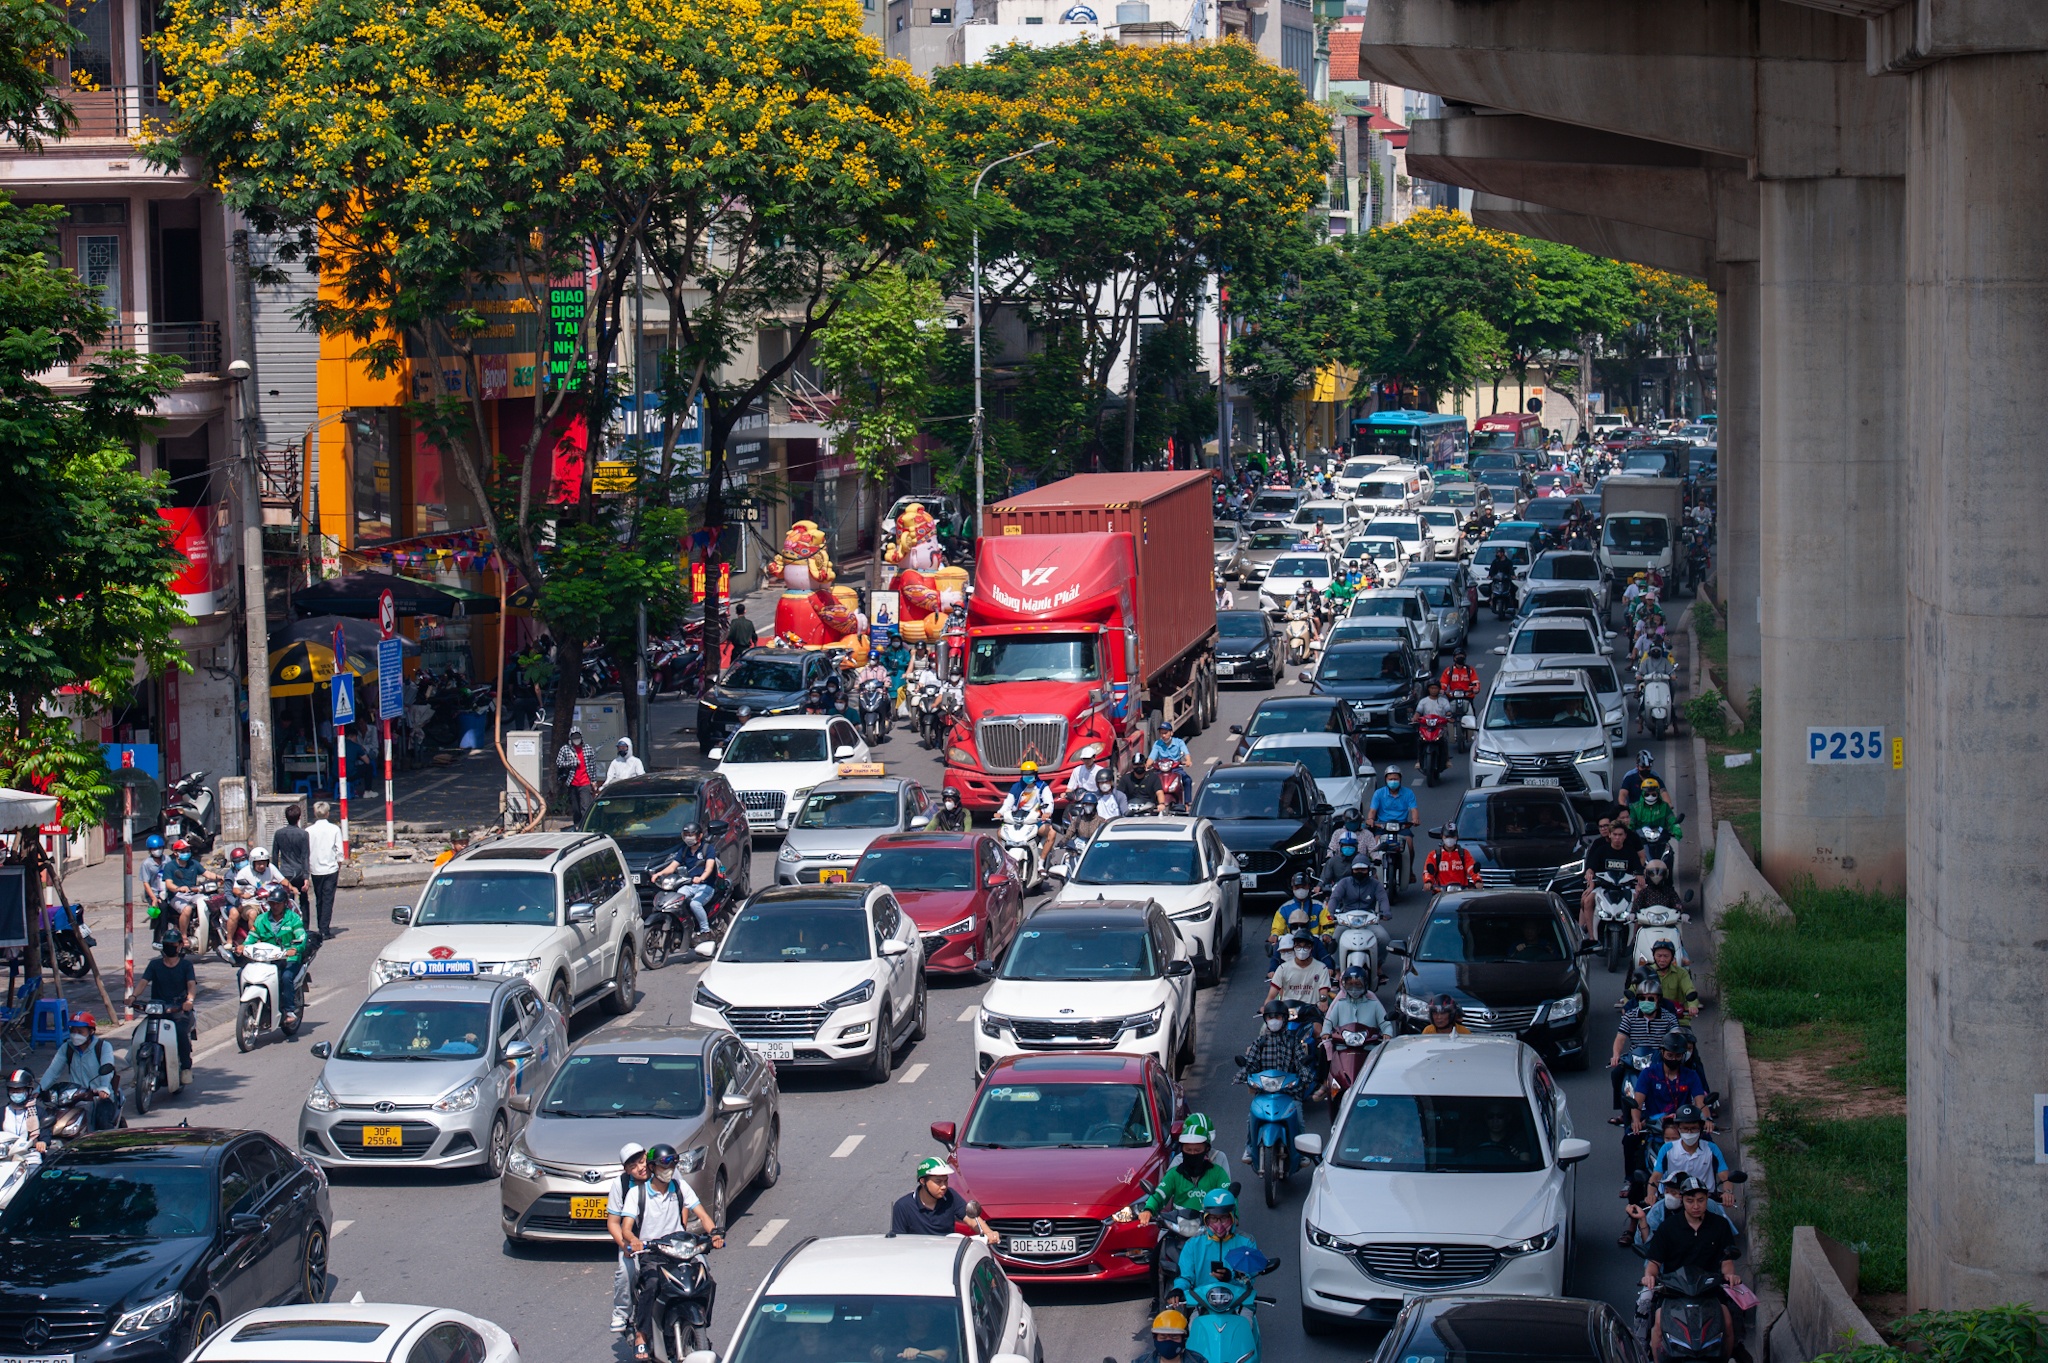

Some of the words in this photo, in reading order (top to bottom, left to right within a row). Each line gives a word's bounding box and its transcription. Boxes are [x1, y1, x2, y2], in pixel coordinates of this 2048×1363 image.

[551, 290, 584, 303] GIAO
[551, 305, 585, 321] DỊCH
[481, 366, 506, 389] Lenovo
[514, 365, 536, 387] acer
[992, 583, 1020, 612] Hoàng
[1021, 597, 1052, 612] Mạnh
[1054, 583, 1080, 607] Phát
[1810, 731, 1882, 760] P235
[428, 961, 444, 973] TRÔI
[446, 960, 471, 972] PHÙNG
[767, 1042, 783, 1050] 30G
[762, 1051, 790, 1059] 761.20
[374, 1127, 390, 1136] 30F
[367, 1137, 398, 1145] 255.84
[1187, 1189, 1207, 1198] Grab
[583, 1198, 601, 1207] 30F
[575, 1208, 609, 1218] 677.96
[1012, 1239, 1074, 1252] 30E-525.49
